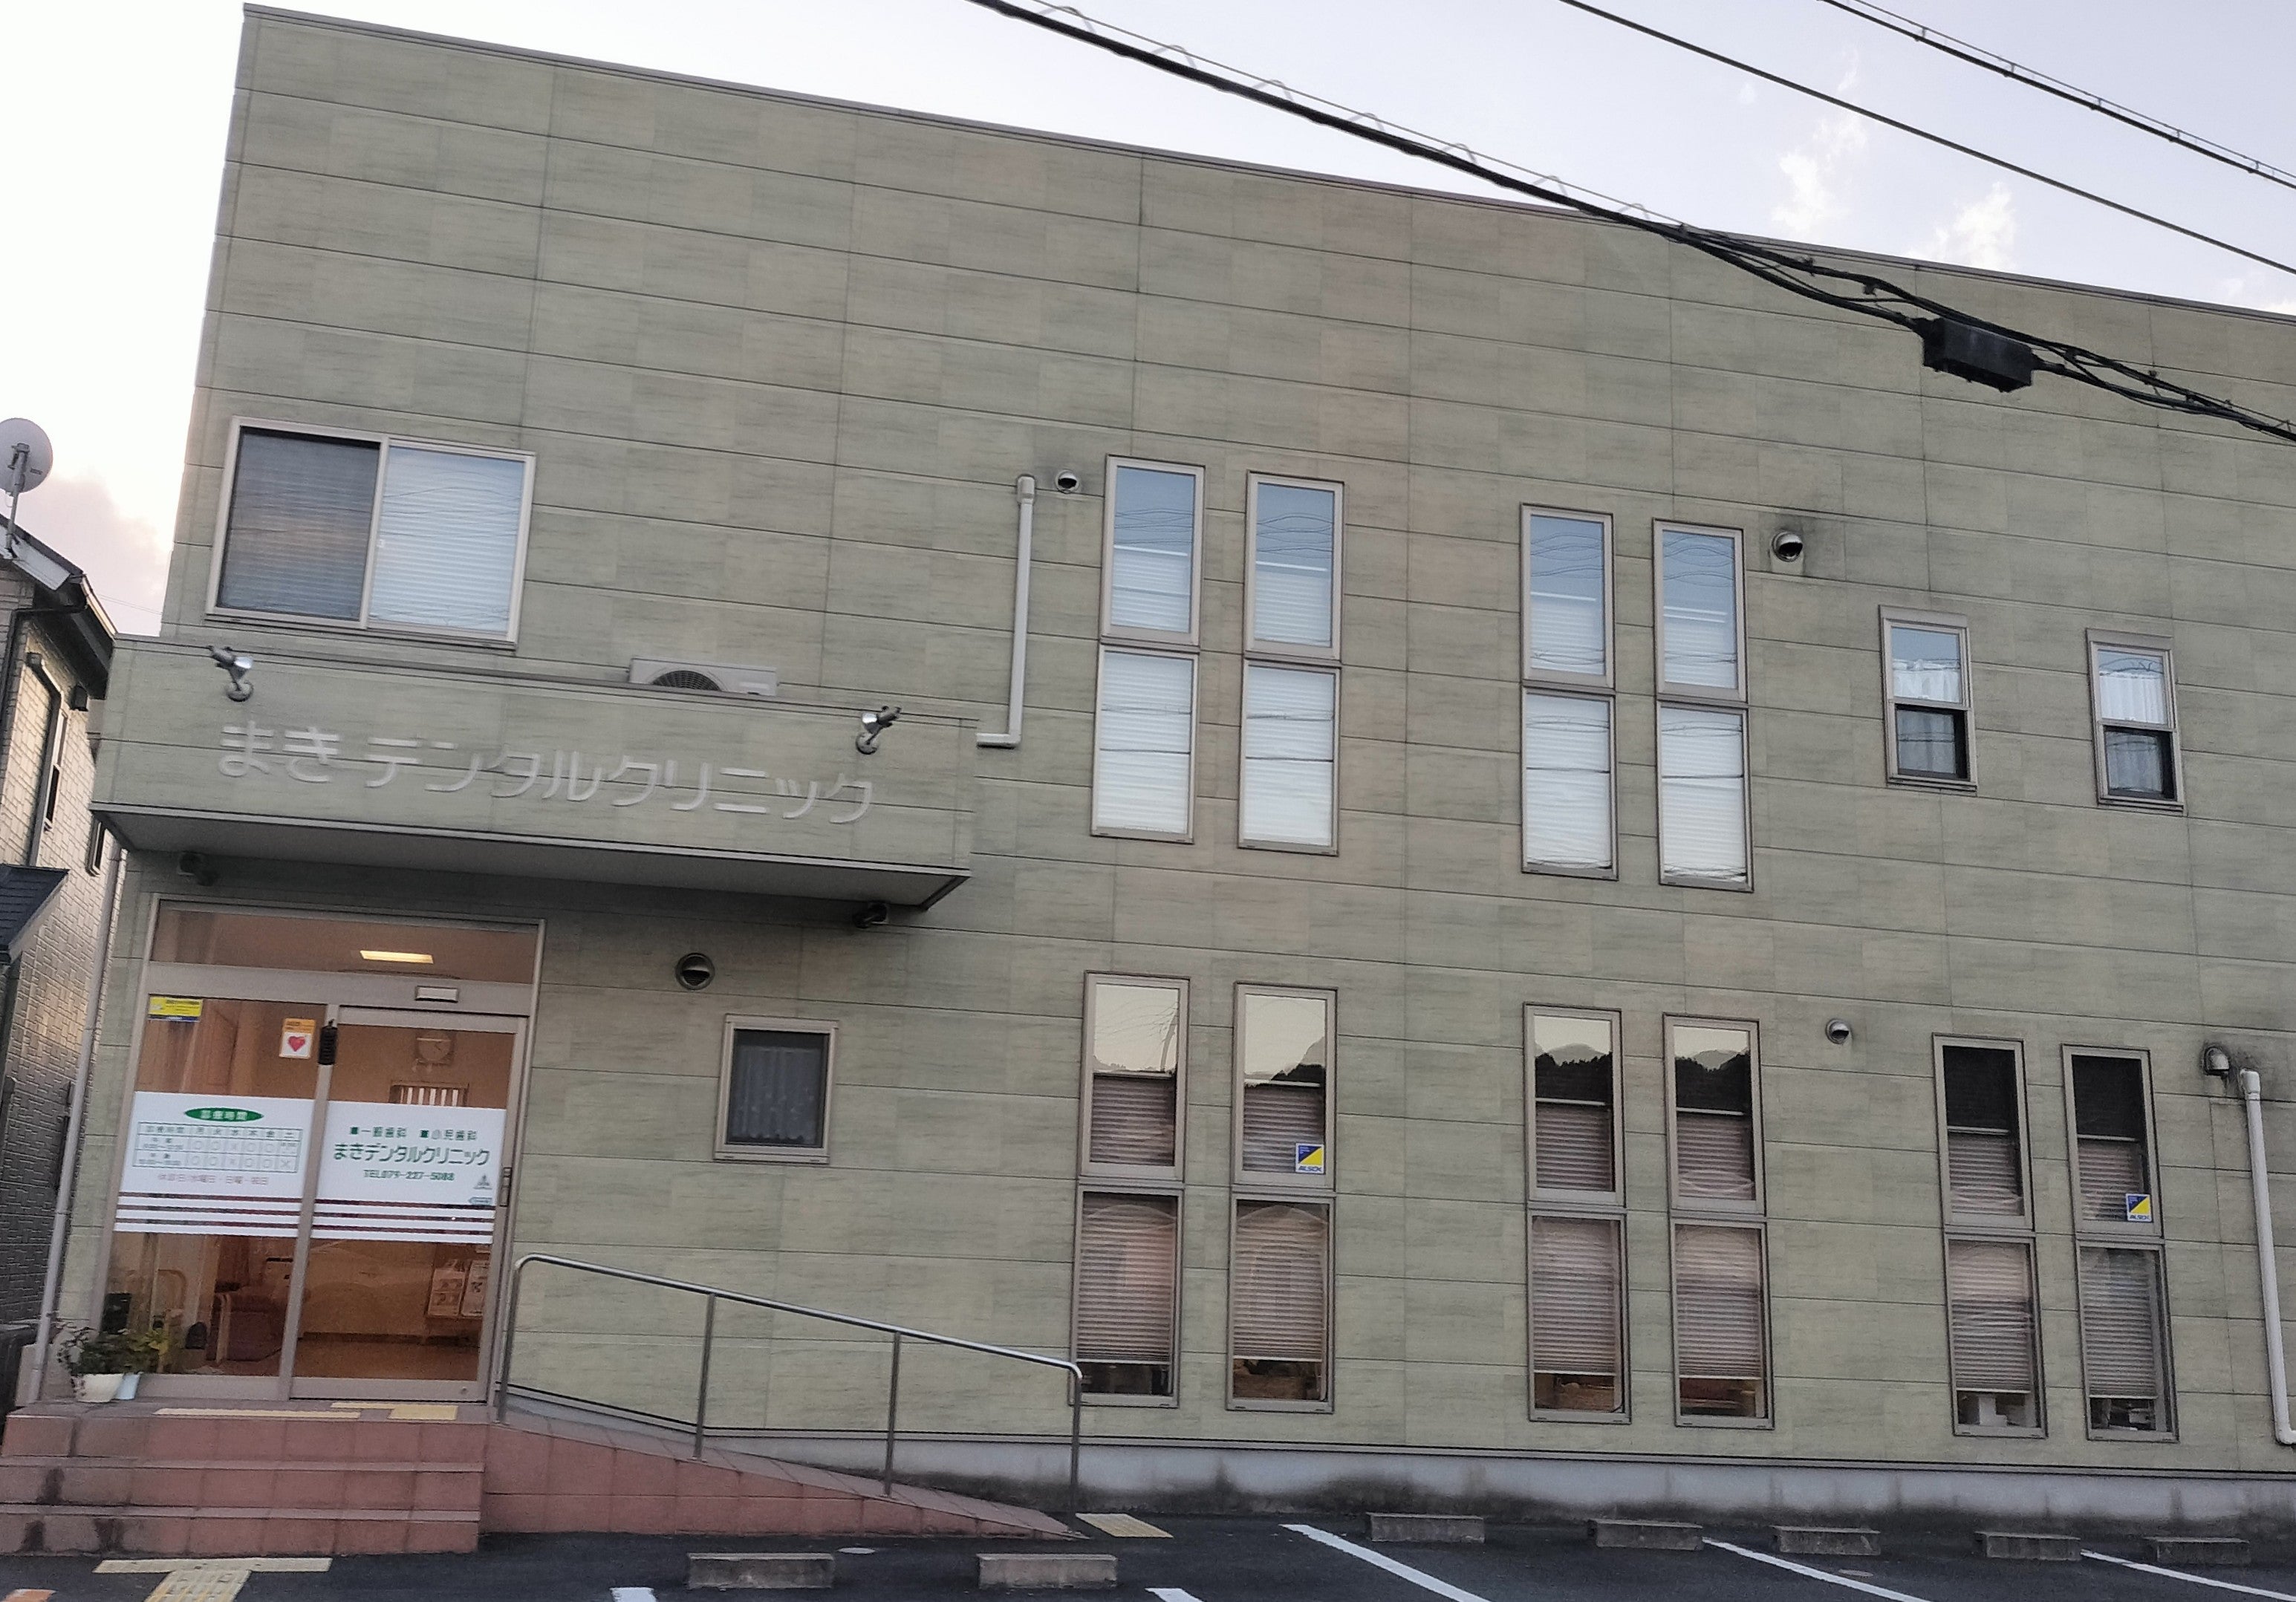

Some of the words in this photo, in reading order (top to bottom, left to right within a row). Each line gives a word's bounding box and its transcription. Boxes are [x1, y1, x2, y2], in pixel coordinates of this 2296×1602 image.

[218, 720, 874, 824] まきデンタルクリニック
[334, 1143, 490, 1166] まきデンタルクリニック
